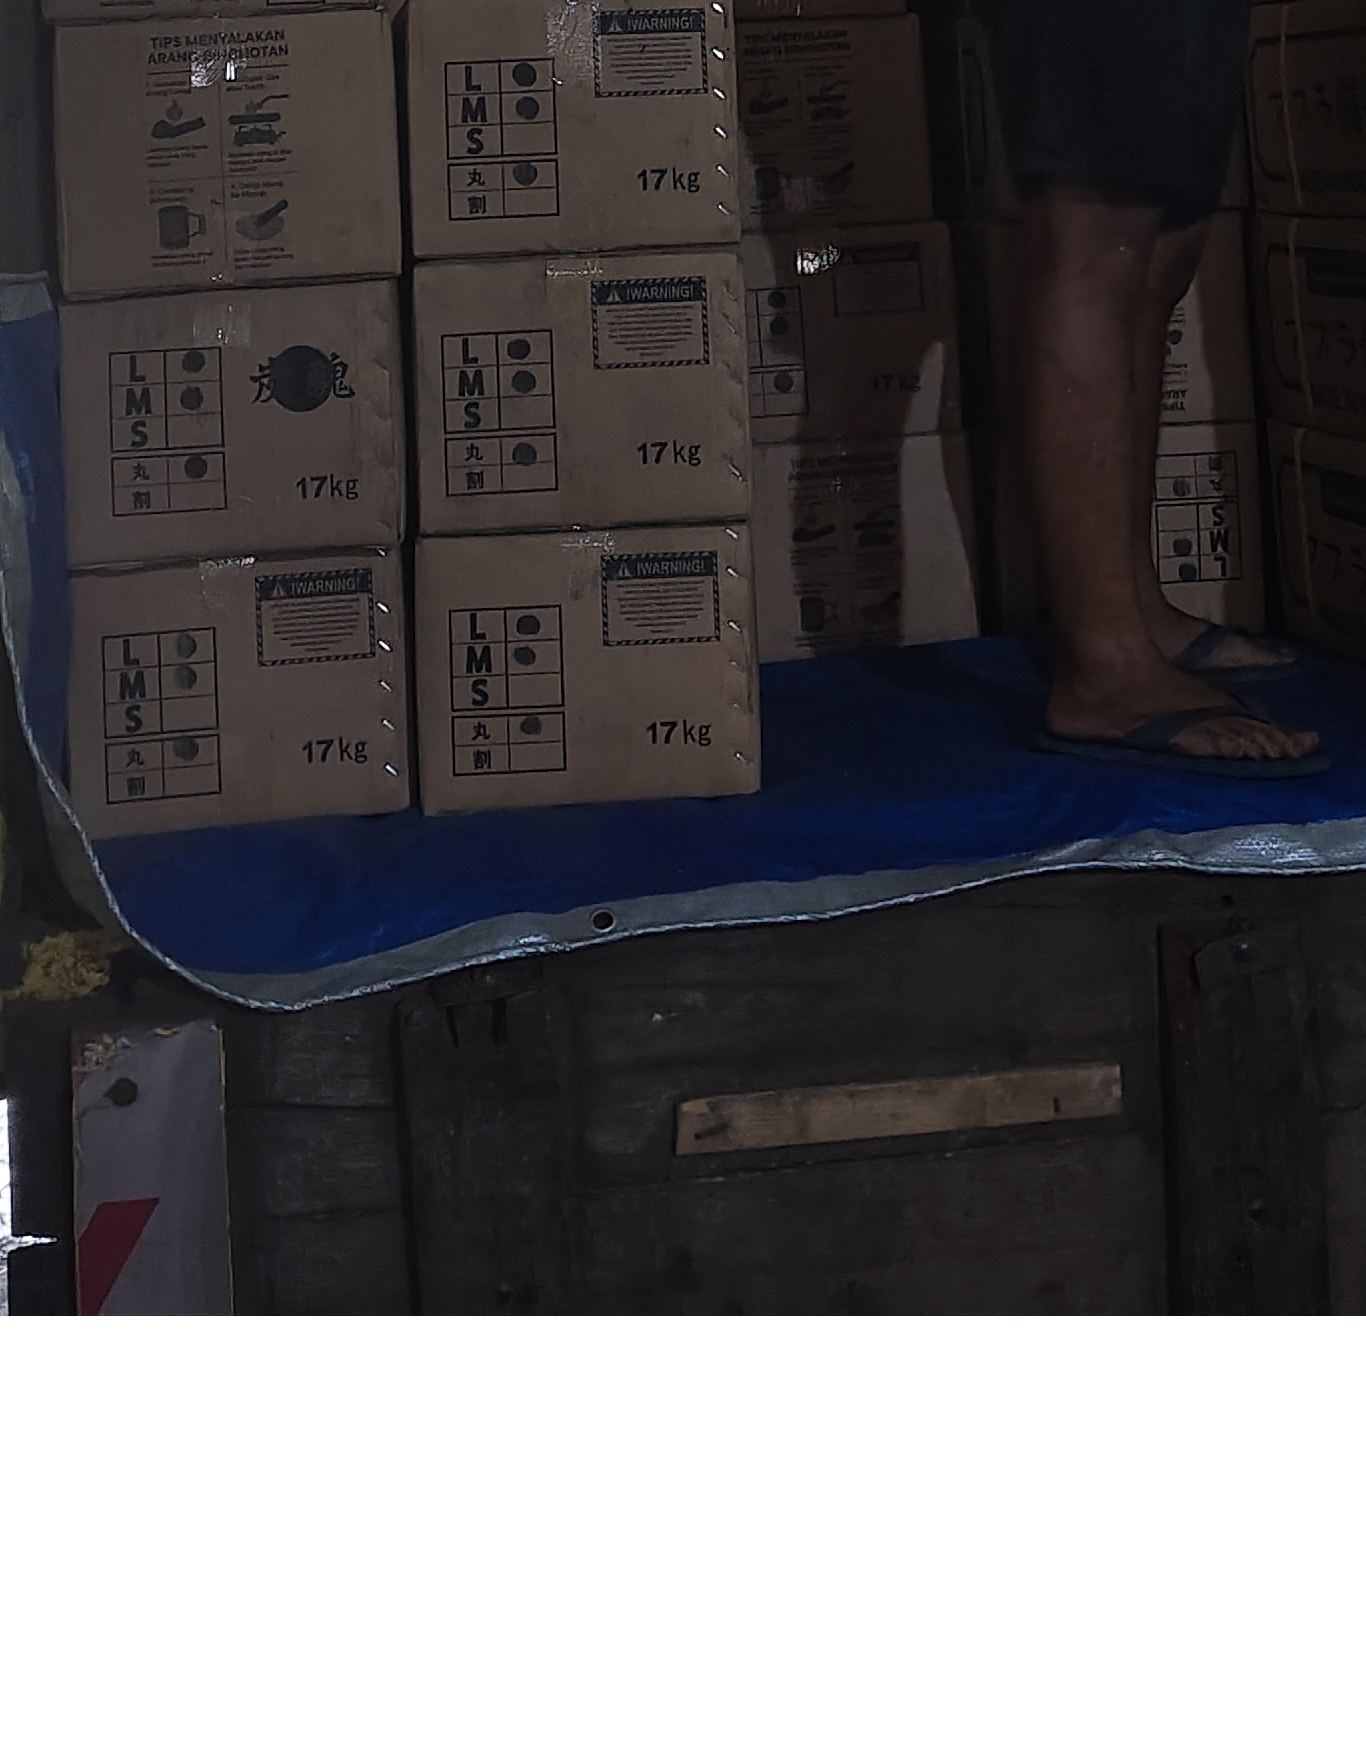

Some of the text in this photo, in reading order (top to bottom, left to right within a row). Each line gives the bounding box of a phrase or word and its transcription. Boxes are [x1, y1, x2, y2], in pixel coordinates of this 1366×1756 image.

[150, 35, 181, 49] TIPS
[465, 66, 481, 91] L
[461, 98, 487, 123] M
[466, 128, 483, 155] S
[462, 338, 478, 364] L
[129, 356, 146, 382] L
[458, 370, 484, 397] M
[125, 388, 151, 415] M
[464, 402, 481, 429] S
[131, 421, 147, 447] S
[470, 613, 486, 640] L
[123, 639, 139, 666] L
[466, 646, 492, 673] M
[119, 671, 145, 700] M
[471, 680, 489, 706] S
[125, 705, 142, 733] S
